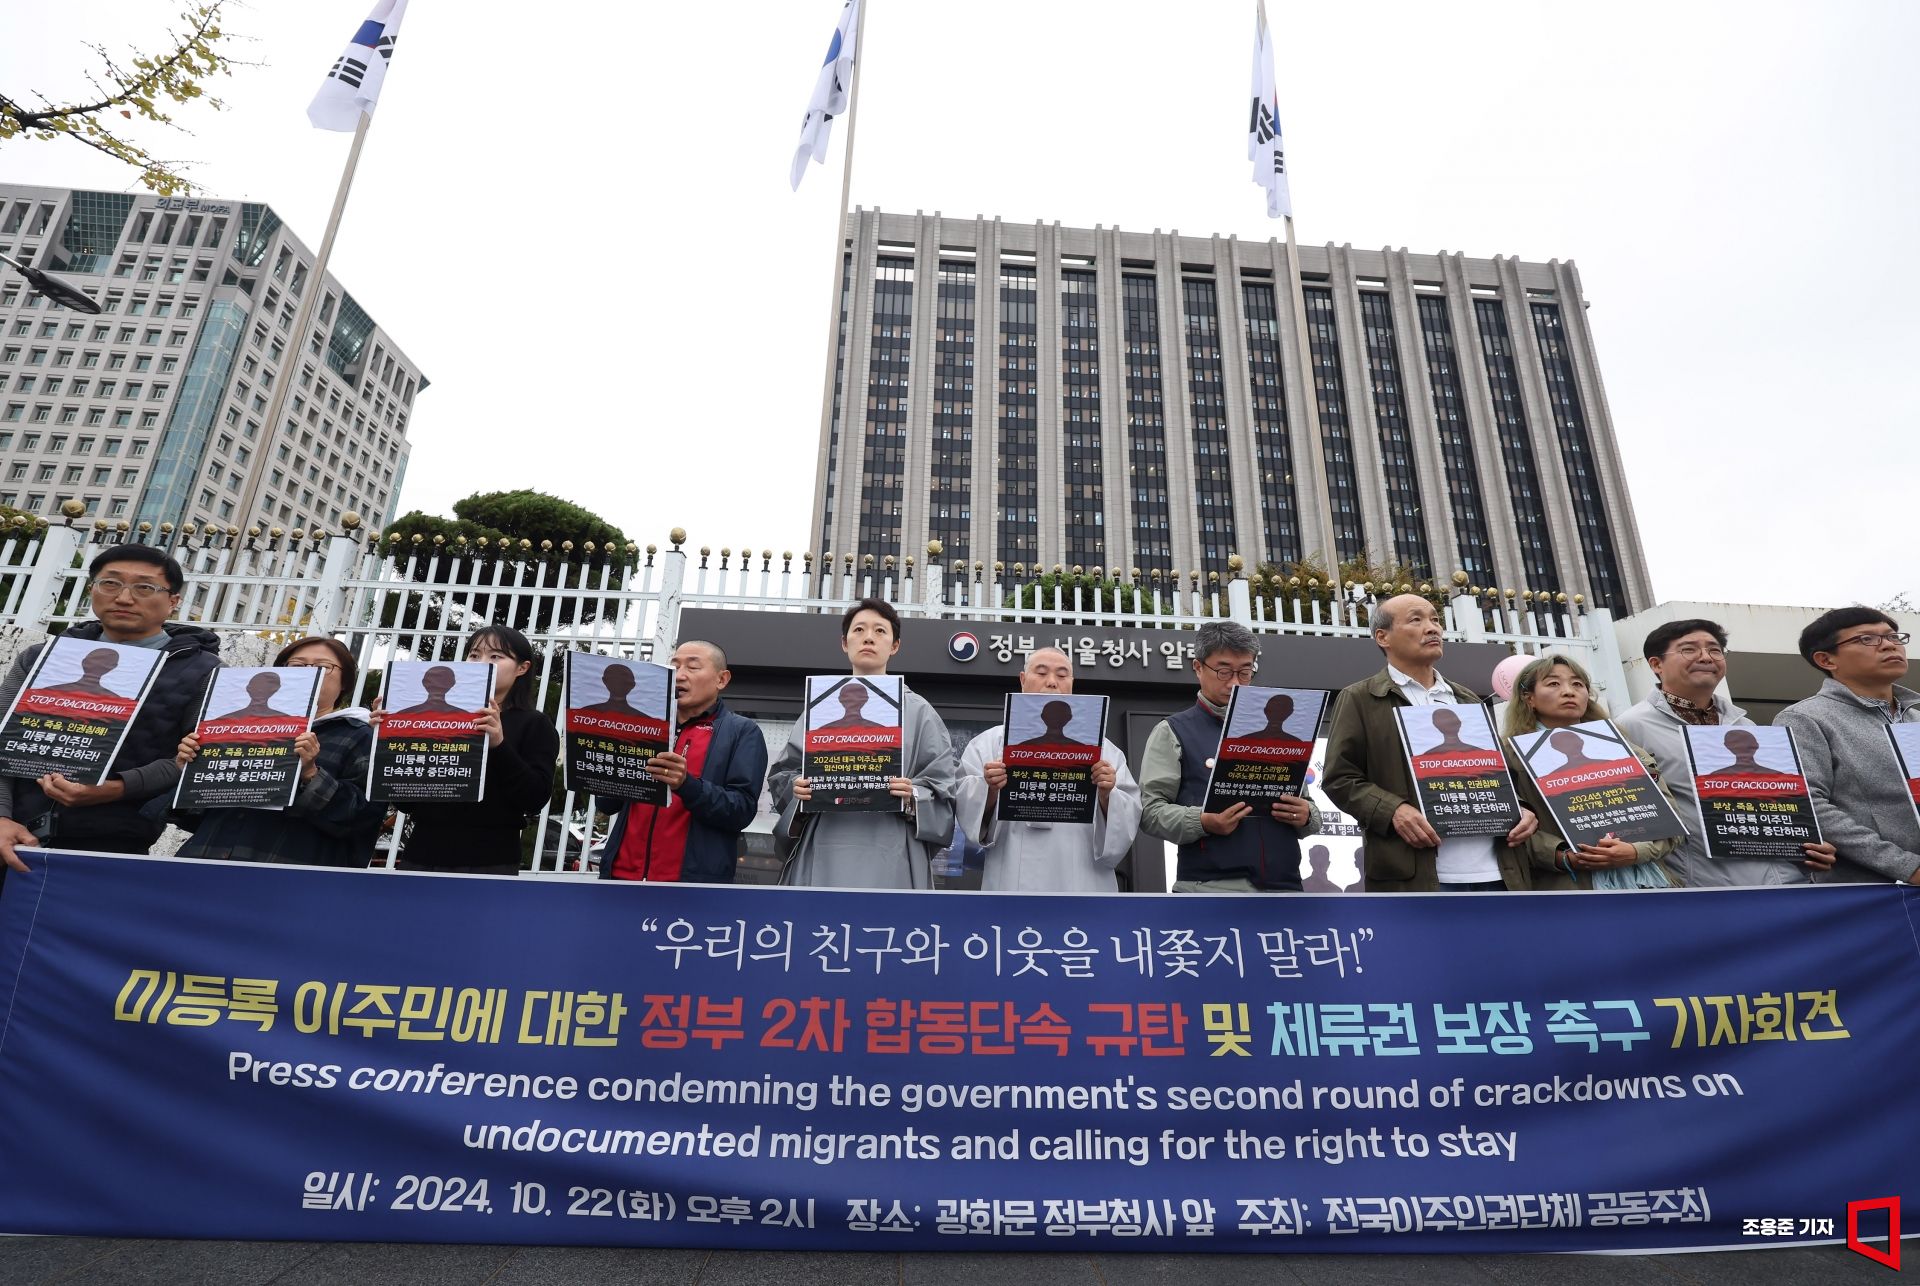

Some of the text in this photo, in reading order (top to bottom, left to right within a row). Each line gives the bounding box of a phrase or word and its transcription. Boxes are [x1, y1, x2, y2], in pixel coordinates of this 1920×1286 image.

[155, 198, 199, 212] 외교부
[201, 204, 230, 214] MOFA
[989, 633, 1036, 662] 정부
[1055, 636, 1152, 668] 서울청사
[27, 695, 125, 714] STOP CRACKDOWN!
[21, 717, 40, 728] 부상,
[387, 720, 412, 728] STOP
[573, 716, 661, 736] STOP CRACKDOWN!
[204, 725, 298, 734] STOP CRACKDOWN!
[23, 730, 93, 748] 미등록 이주민
[578, 738, 595, 749] 부상,
[836, 735, 894, 743] CRACKDOWN!
[5, 741, 100, 761] 단속추방 중단하라!
[388, 743, 408, 752] 부상,
[1227, 745, 1305, 755] STOP CRACKDOWN!
[202, 749, 221, 757] 부상,
[1010, 751, 1093, 760] STOP CRACKDOWN!
[208, 760, 274, 770] 미등록 이주민
[396, 755, 459, 765] 미등록 이주민
[585, 751, 646, 769] 미등록 이주민
[1442, 759, 1497, 767] CRACKDOWN!
[384, 767, 471, 777] 단속추방 중단하라!
[576, 761, 614, 775] 단속추방
[193, 772, 285, 782] 단속추방 중단하라!
[1012, 771, 1030, 779] 부상,
[1546, 766, 1633, 789] STOP CRACKDOWN!
[1020, 782, 1076, 792] 미등록 이주민
[1429, 782, 1447, 790] 부상,
[1731, 781, 1797, 790] CRACKDOWN!
[1010, 792, 1087, 802] 단속추방 중단하라!
[1440, 792, 1496, 802] 미등록 이주민
[1570, 793, 1602, 804] 2024년
[1603, 788, 1627, 797] 상반기
[1608, 797, 1623, 805] 사망
[1434, 803, 1511, 815] 단속추방 중단하라!
[1713, 802, 1735, 811] 부상,
[1725, 814, 1792, 824] 미등록 이주민
[1717, 825, 1809, 837] 단속추방 중단하라!
[809, 924, 949, 975] 친구와
[964, 926, 1099, 977] 이웃을
[1111, 928, 1243, 978] 내쫓지
[115, 970, 1850, 1056] 미등록 이주민에 대한 정부 2차 합동단속 규탄 및 체류권 보장 촉구 기자회견
[229, 1052, 1743, 1112] Press conference condemning the government's second round of crackdowns on
[464, 1120, 1516, 1166] undocumented migrants and calling for the right to stay
[303, 1172, 1710, 1236] 일시: 2024. 10. 22(화) 오후 2시 장소: 광화문 정부청사 앞 주최: 전국이주인권단체 공동주최
